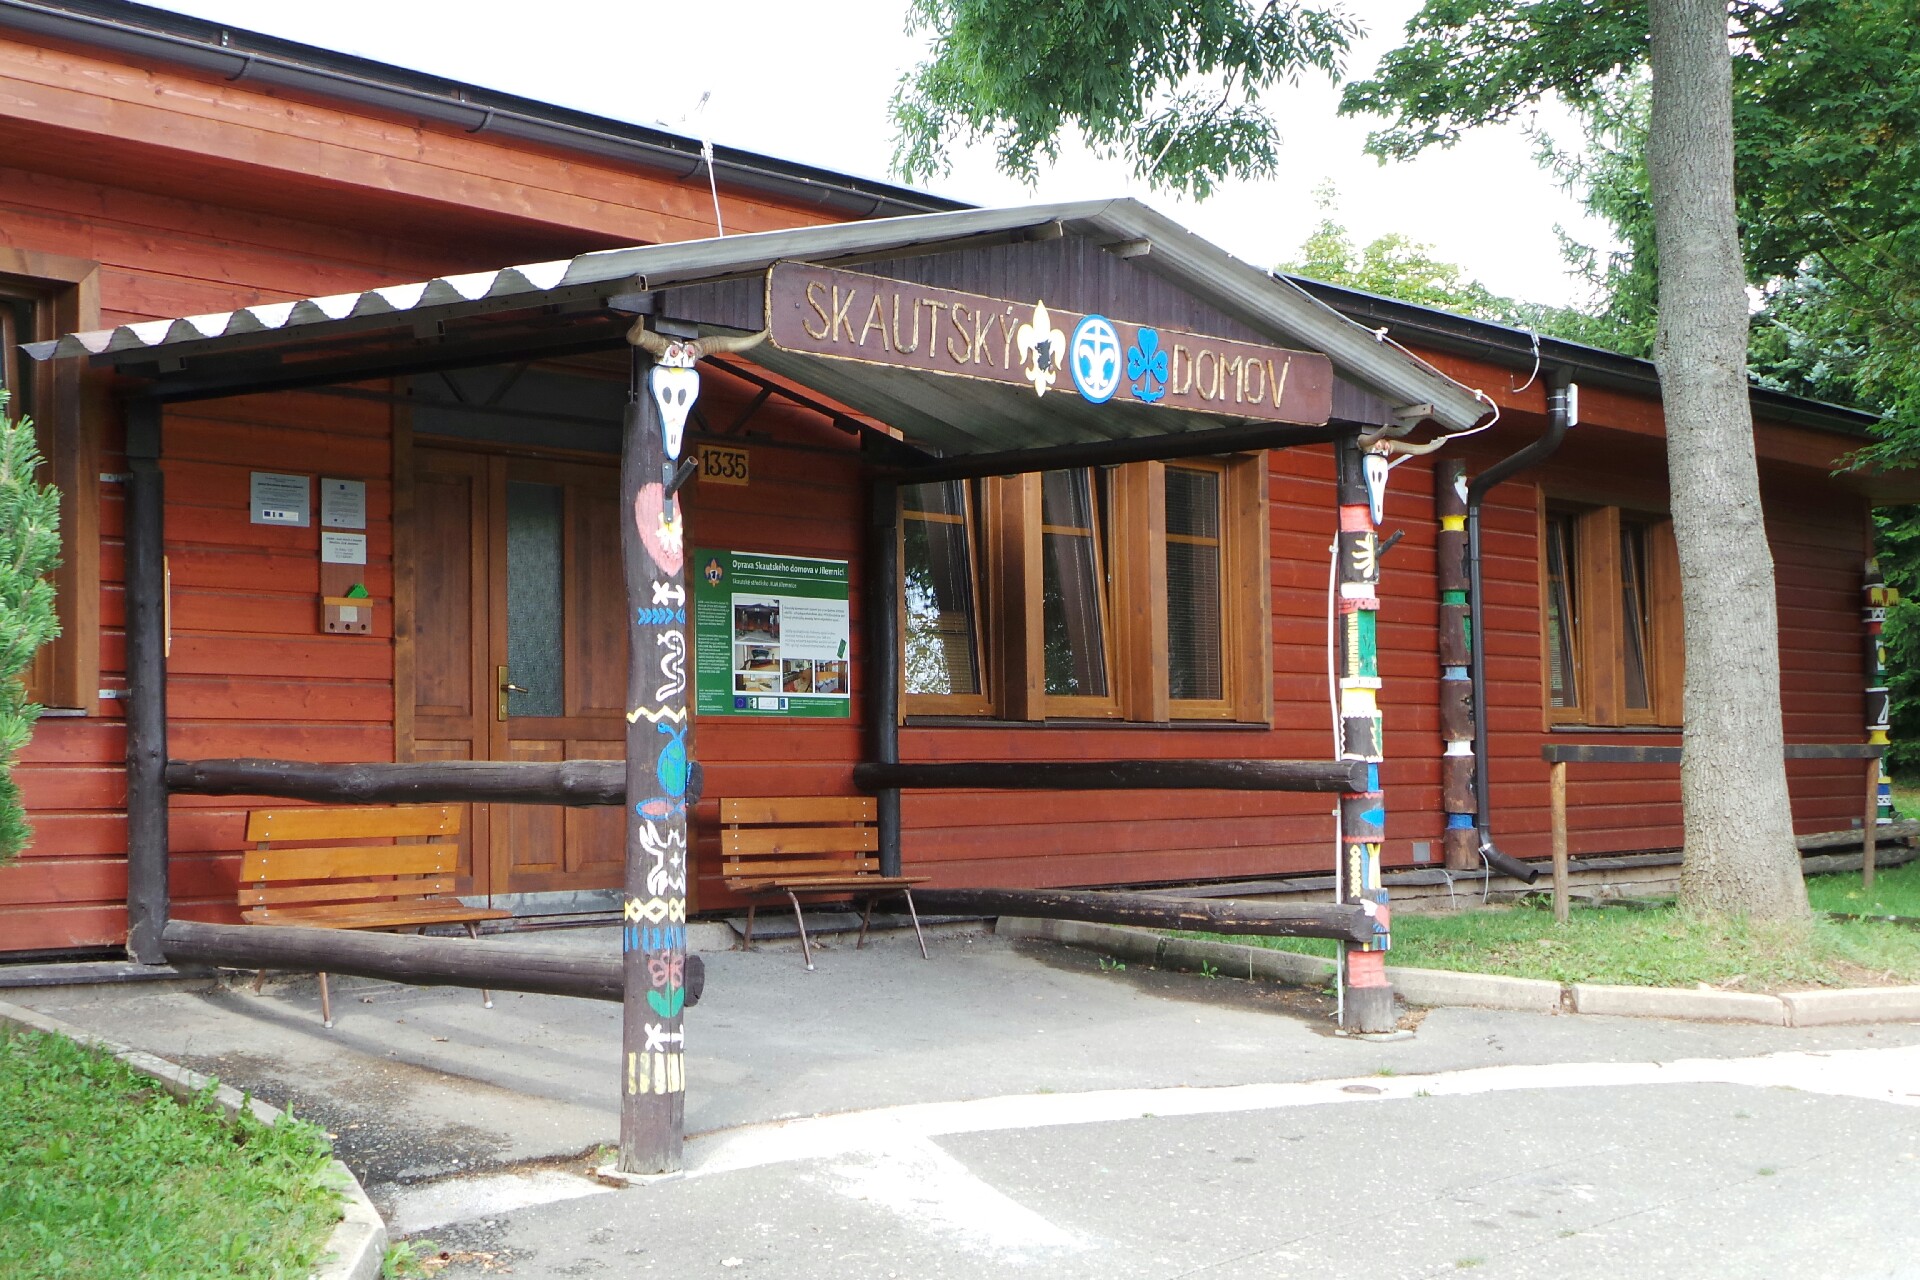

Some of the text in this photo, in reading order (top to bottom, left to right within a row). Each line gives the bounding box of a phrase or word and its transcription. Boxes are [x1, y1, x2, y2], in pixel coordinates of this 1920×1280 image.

[803, 280, 1291, 408] SKAUTSKÝ DOMOV
[703, 450, 747, 479] 1335
[732, 560, 754, 570] Oprava
[755, 561, 789, 572] Skautského
[790, 563, 813, 574] domova
